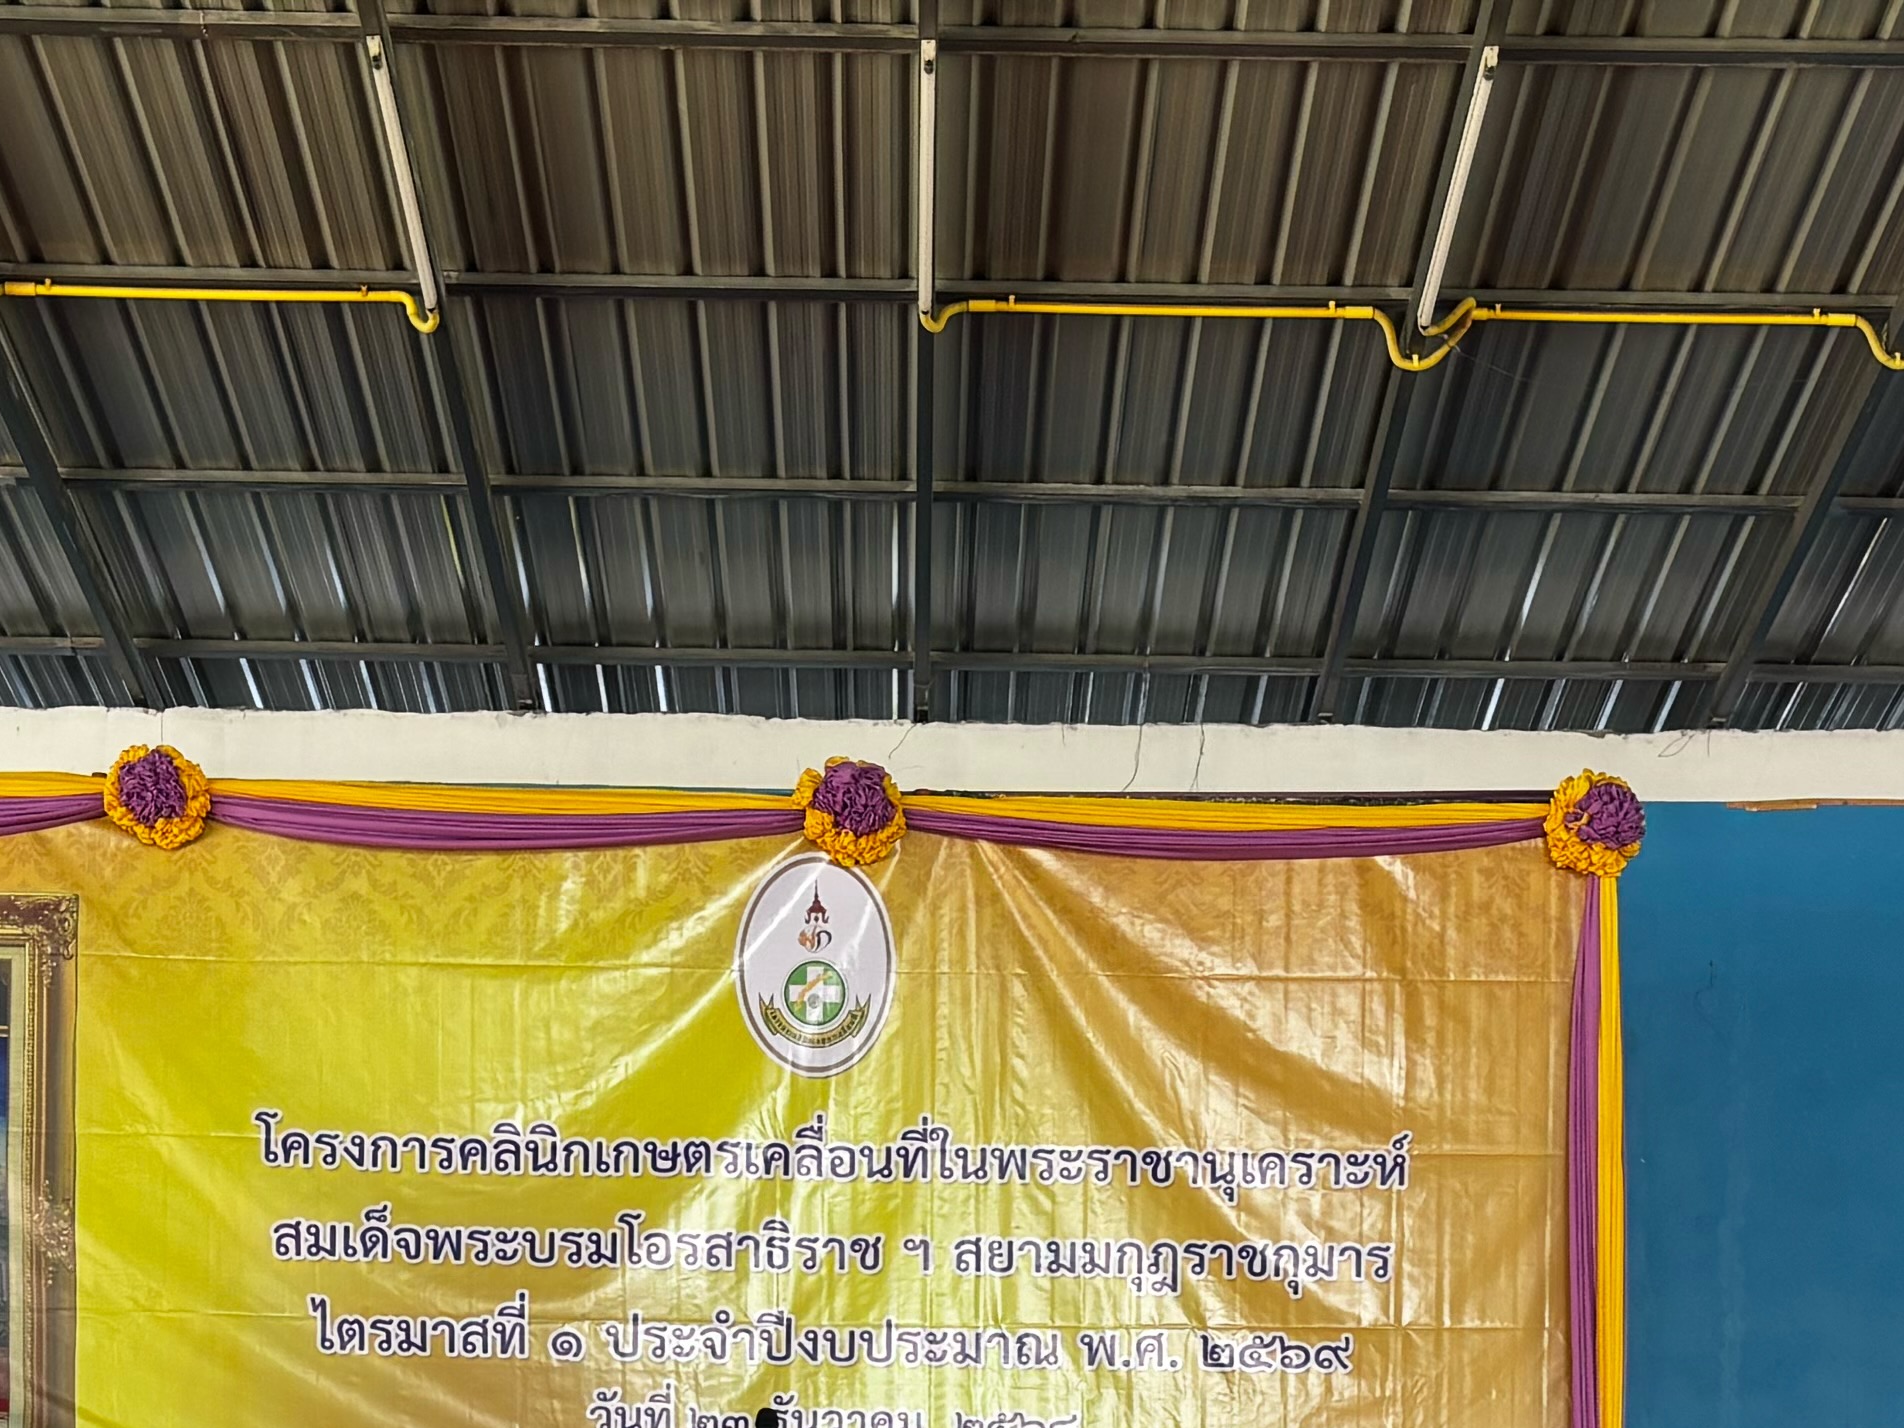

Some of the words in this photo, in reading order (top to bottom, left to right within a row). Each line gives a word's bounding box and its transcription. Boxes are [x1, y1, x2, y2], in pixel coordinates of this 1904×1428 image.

[254, 1111, 1410, 1203] โครงการคลินิกเกษตรเคลื่อนที่ในพระราชานุเคราะห์
[273, 1204, 882, 1271] สมเด็จพระบรมโอรสาธิราช
[903, 1238, 930, 1271] ฯ
[310, 1292, 526, 1358] ไตรมาสที่
[551, 1329, 583, 1358] ๑
[605, 1309, 1058, 1366] ประจำปีงบประมาณ
[1080, 1332, 1178, 1368] พ.ศ.
[1200, 1332, 1353, 1370] ๒๕๖๙
